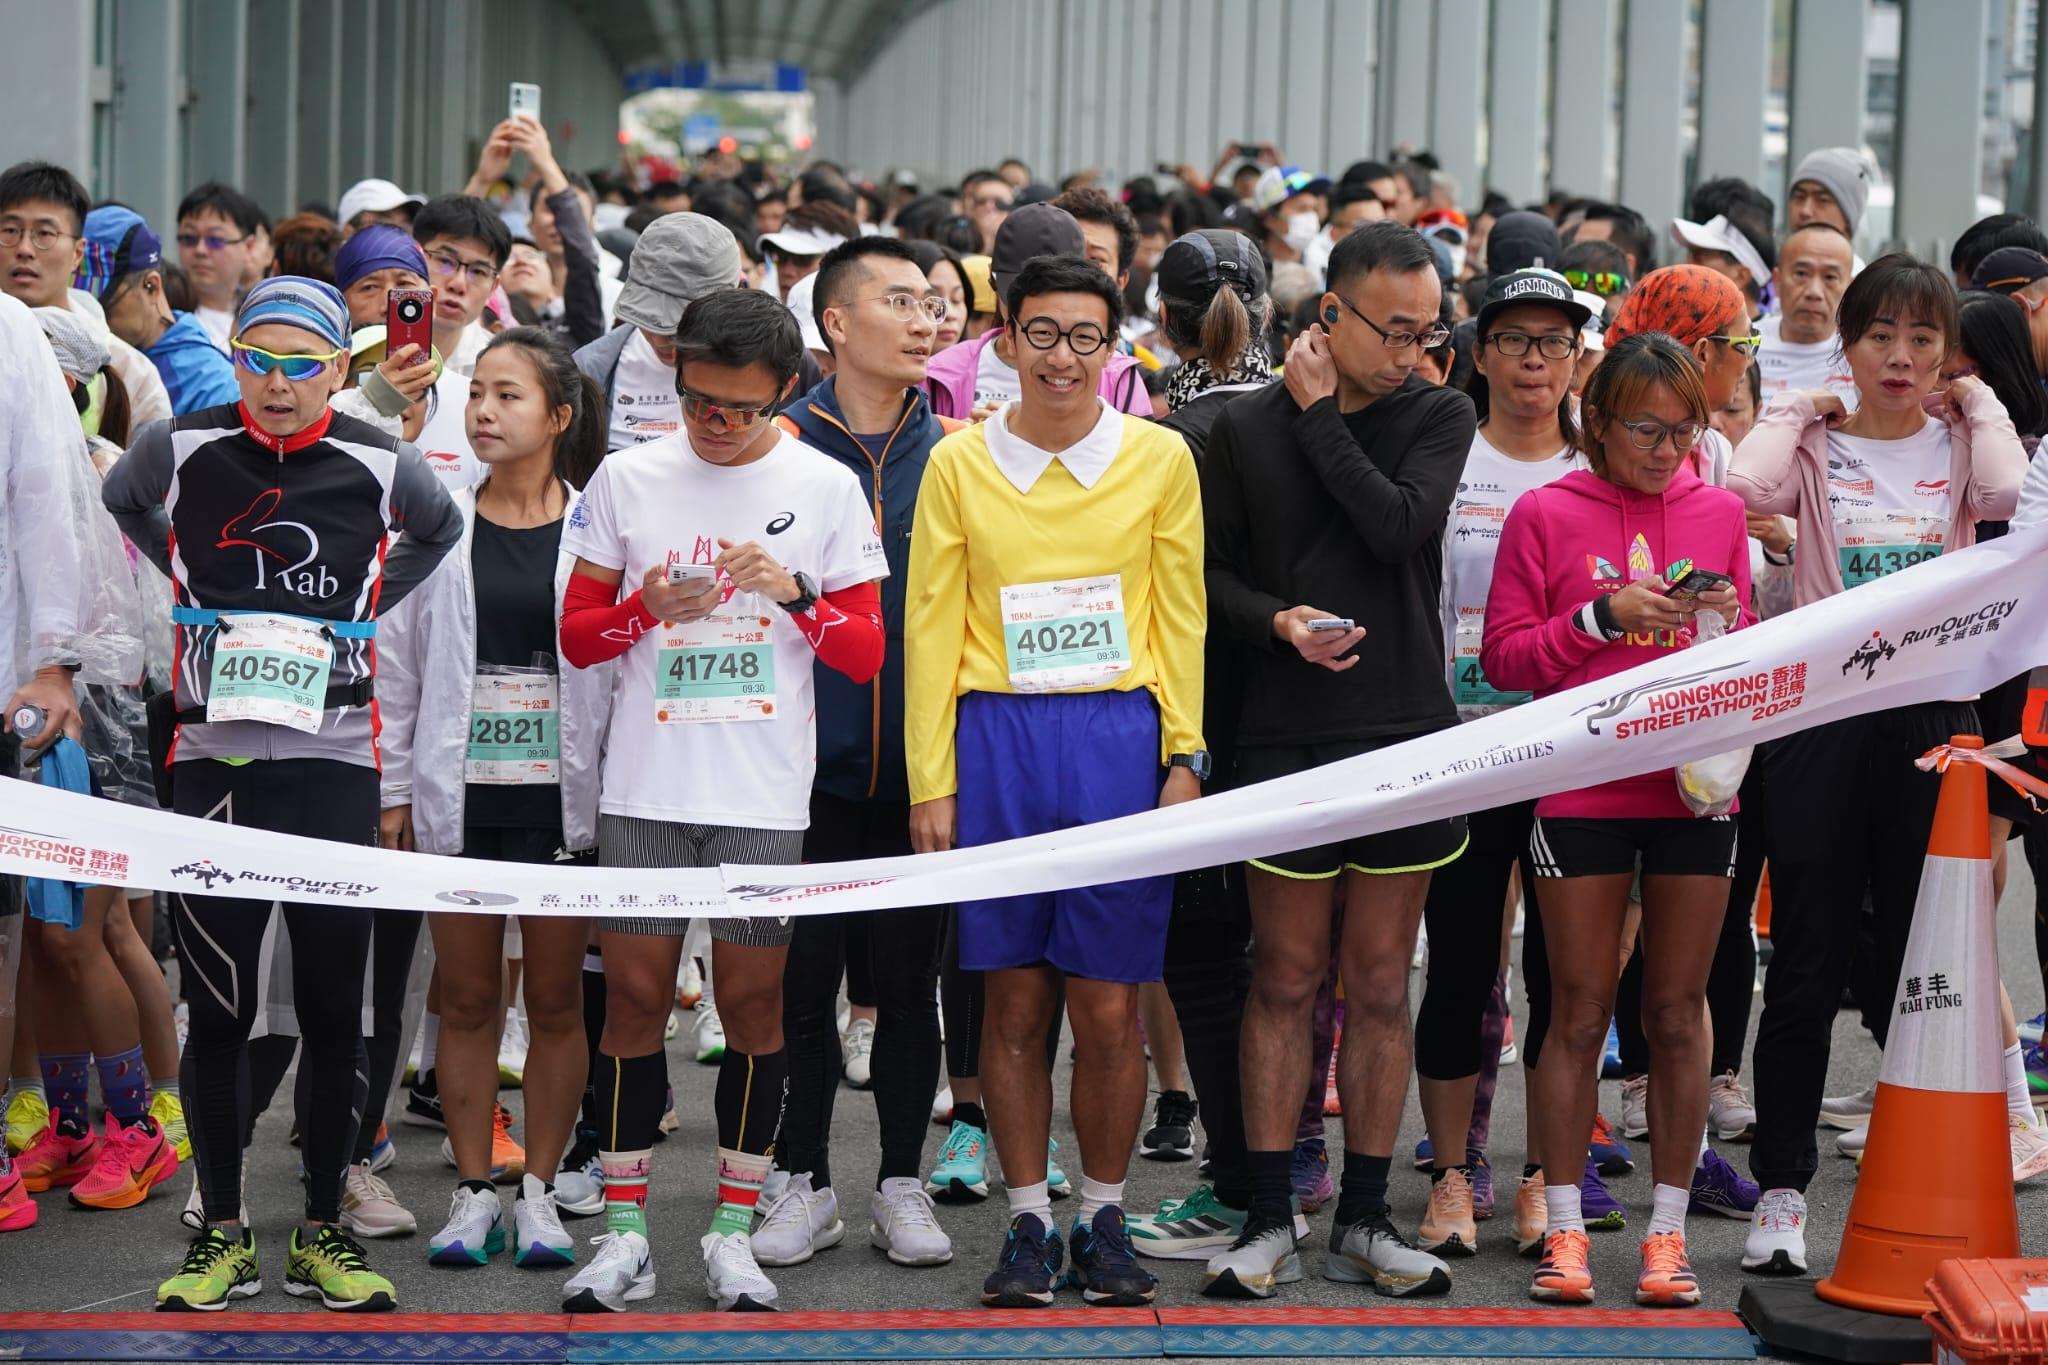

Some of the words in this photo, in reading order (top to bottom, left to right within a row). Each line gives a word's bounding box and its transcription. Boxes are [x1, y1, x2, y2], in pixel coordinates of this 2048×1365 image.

[1844, 536, 1865, 545] 10KM
[1085, 600, 1115, 612] 十公里
[1010, 611, 1033, 621] 10KM
[1900, 598, 2019, 648] RunOurCity
[735, 631, 765, 643] 十公里
[1017, 619, 1113, 654] 40221
[1934, 617, 2000, 647] 全城街馬
[223, 640, 243, 649] 10KM
[297, 643, 325, 658] 十公里
[667, 638, 685, 648] 10KM
[1097, 650, 1120, 660] 09:30
[219, 655, 320, 690] 40567
[669, 651, 760, 681] 41748
[1771, 661, 1808, 686] 香港
[742, 684, 765, 694] 09:30
[1647, 673, 1768, 714] HONGKONG
[1770, 679, 1805, 702] 街馬
[522, 699, 550, 710] 十公里
[1752, 696, 1803, 721] 2023
[1616, 690, 1767, 740] STREETATHON
[527, 749, 549, 758] 09:30
[90, 848, 129, 863] 香港
[69, 867, 128, 880] 2023
[89, 859, 129, 873] 街馬
[239, 871, 379, 893] RunOurCity
[1905, 973, 1949, 999] 華丰
[1900, 998, 1922, 1015] WAH
[1925, 993, 1962, 1010] FUNG
